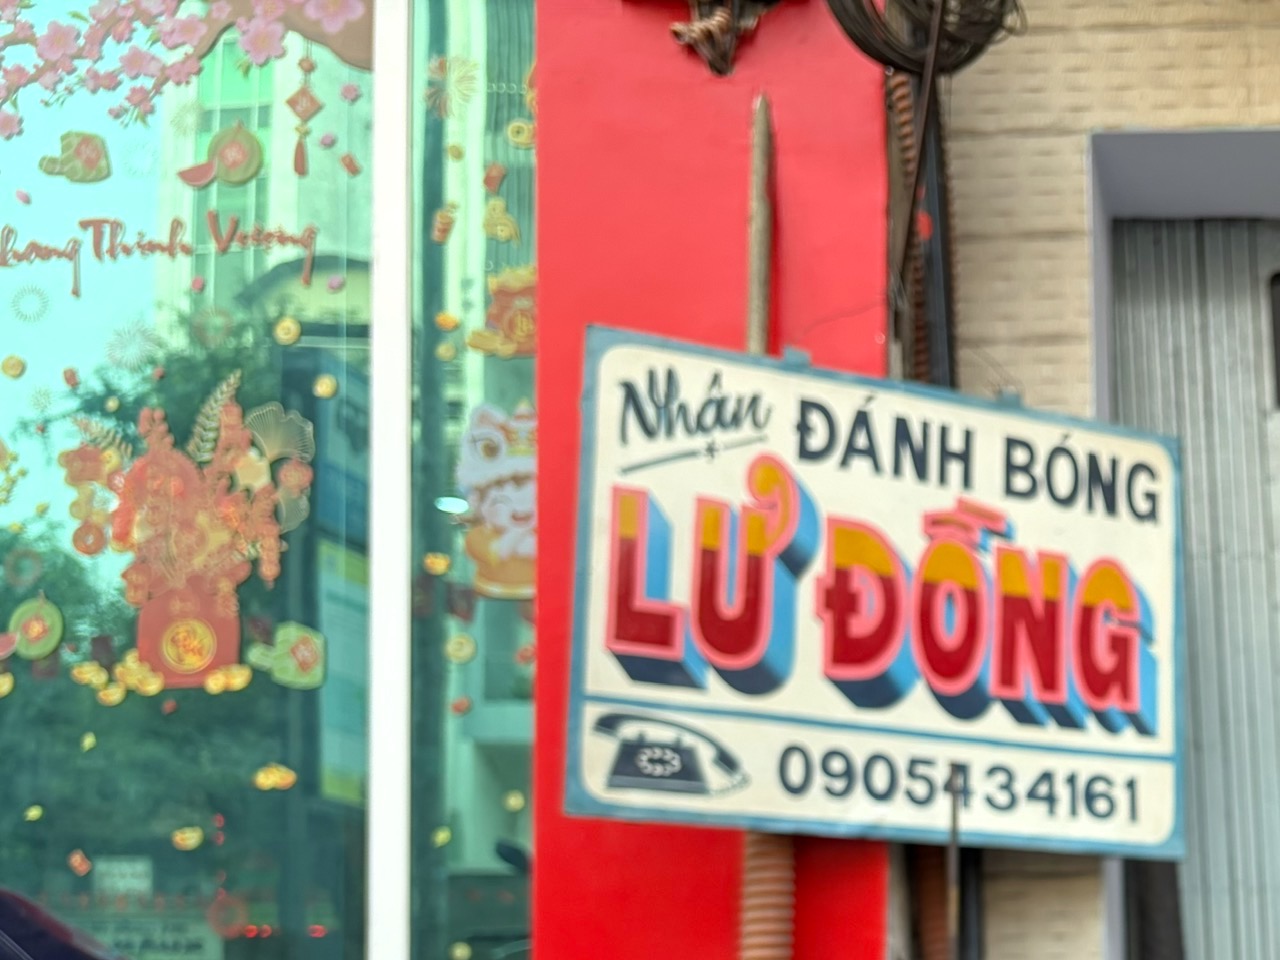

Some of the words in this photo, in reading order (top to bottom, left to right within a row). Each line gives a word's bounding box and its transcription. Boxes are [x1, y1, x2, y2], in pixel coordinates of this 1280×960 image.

[619, 367, 774, 458] Nhận
[795, 394, 976, 490] ĐÁNH
[1003, 430, 1162, 525] BÓNG
[605, 453, 815, 690] LƯ
[815, 497, 1152, 728] ĐỒNG
[778, 744, 1140, 825] 0905434161
